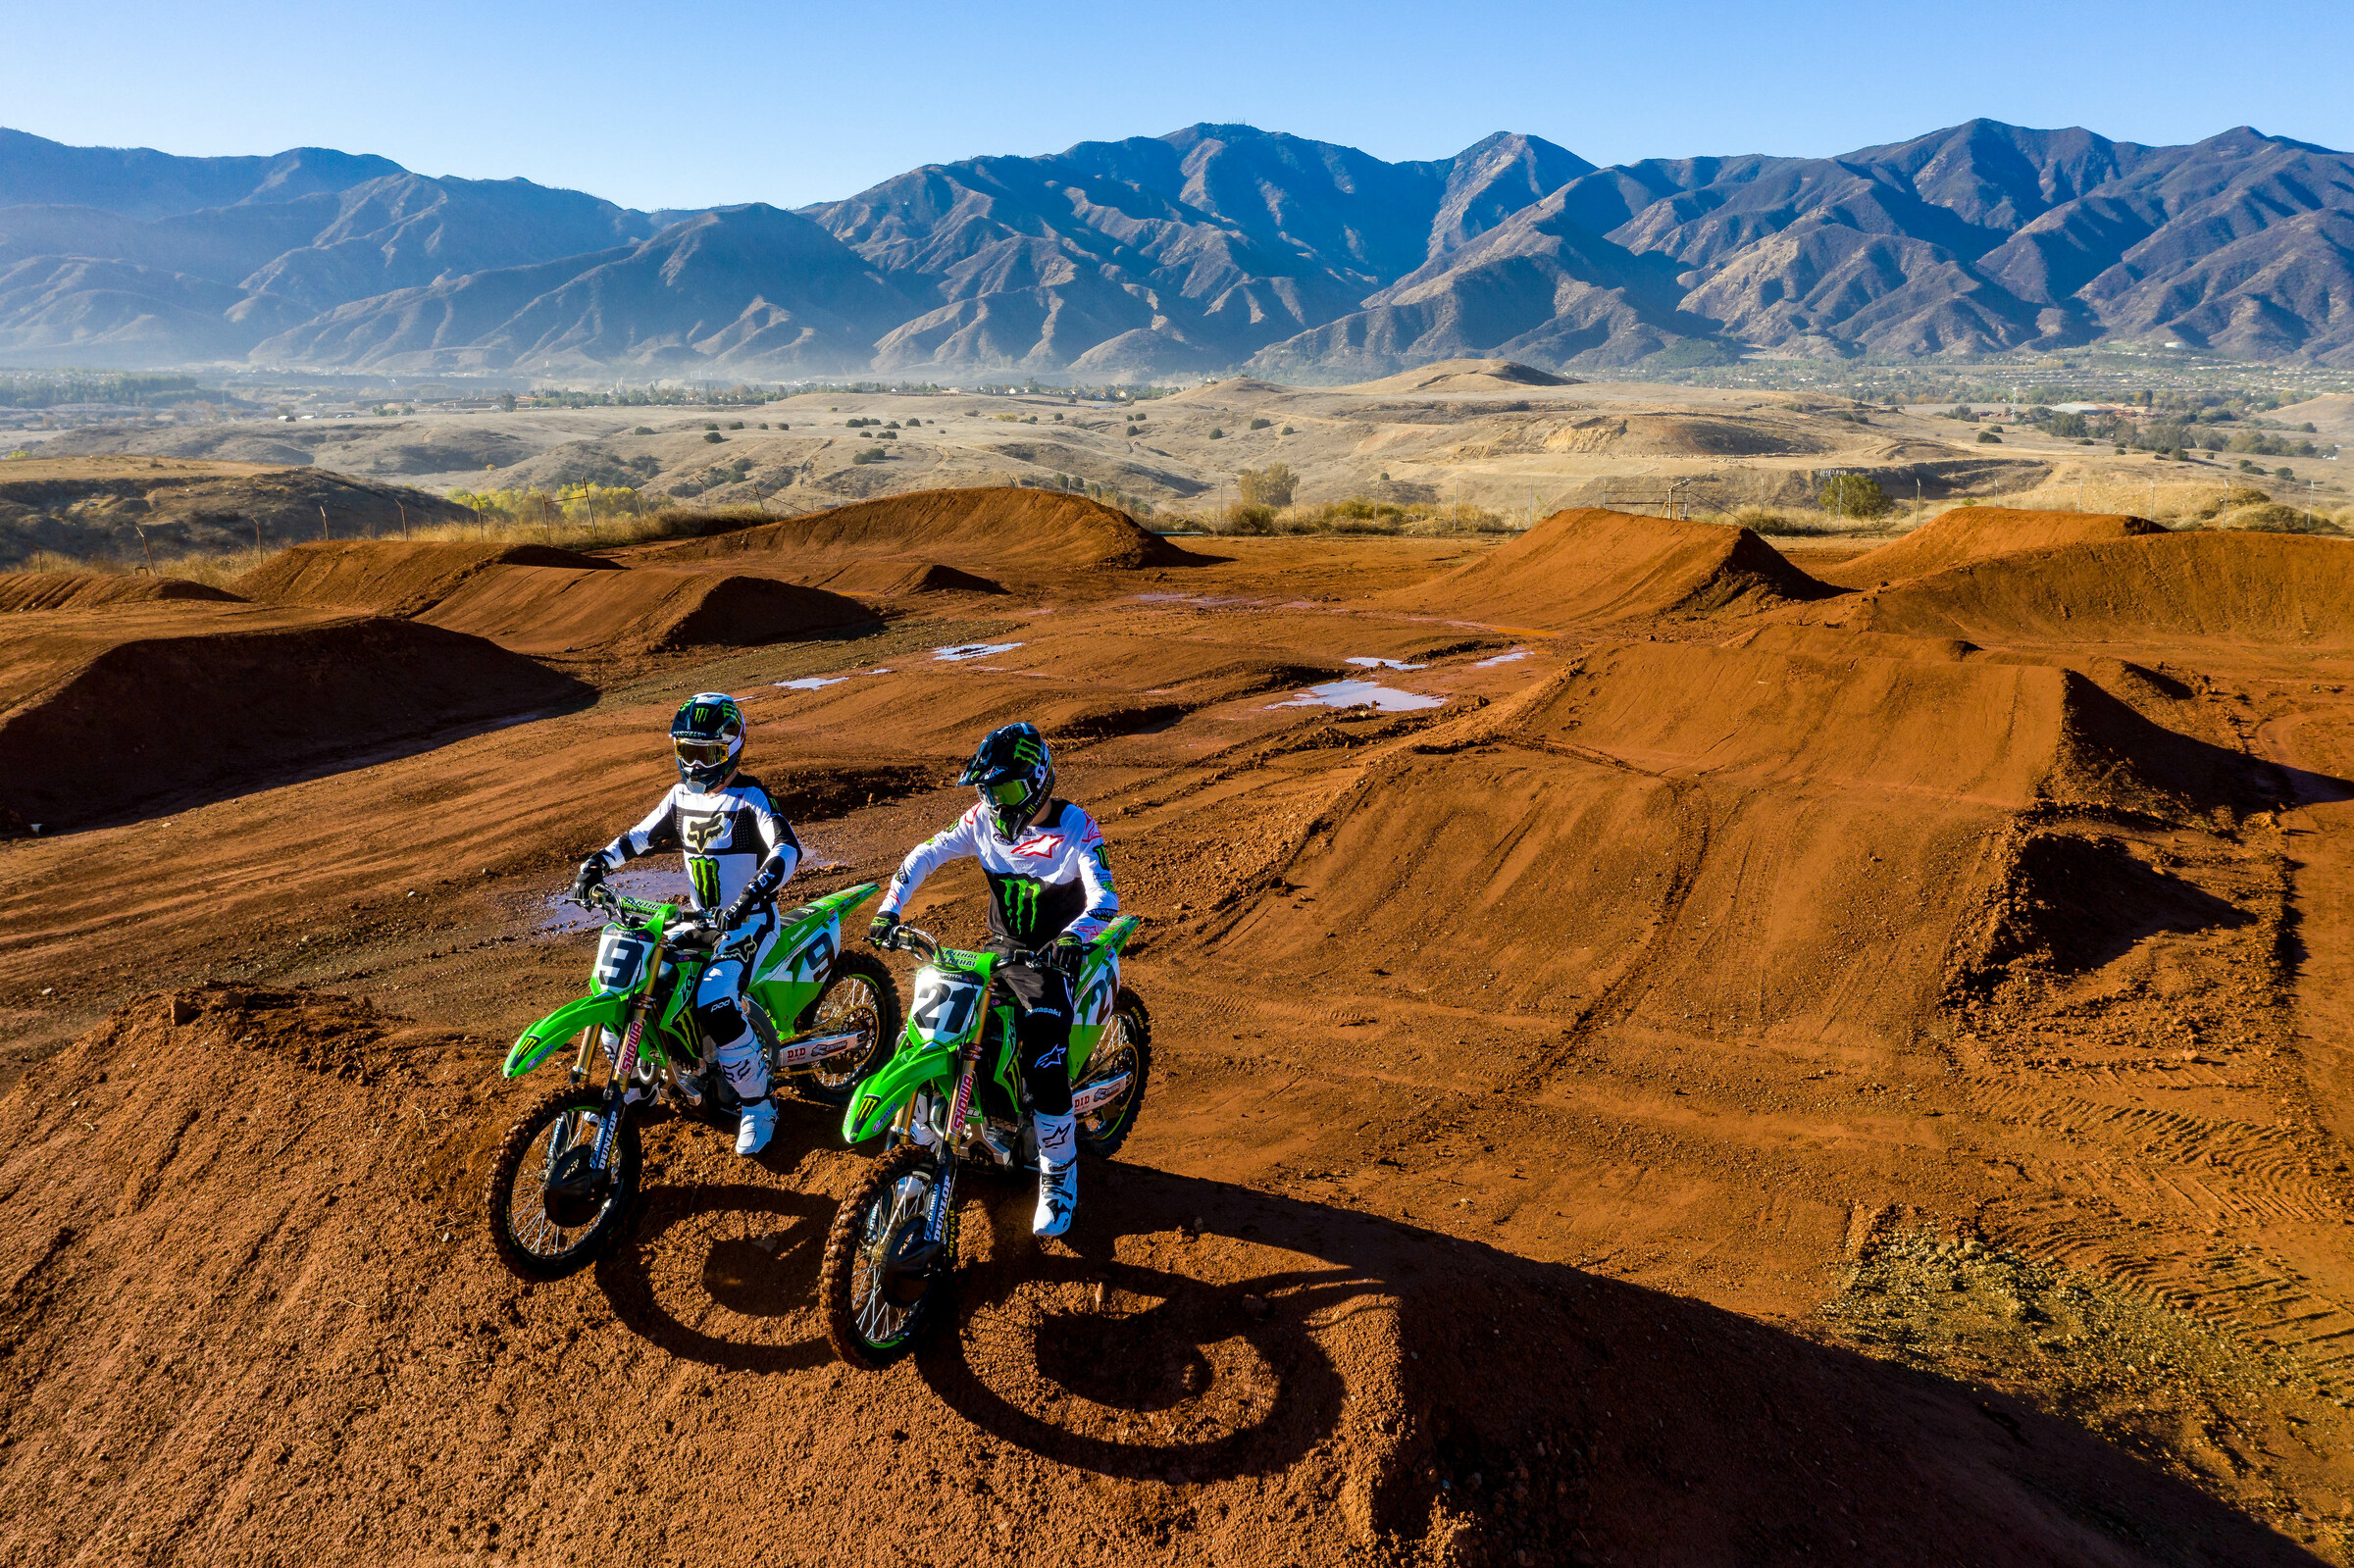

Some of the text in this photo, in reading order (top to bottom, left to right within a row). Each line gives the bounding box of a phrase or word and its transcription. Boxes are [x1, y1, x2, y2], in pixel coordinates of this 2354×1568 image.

[624, 897, 662, 910] RENTHA
[748, 868, 775, 893] FOX
[841, 896, 861, 914] DUNLOP
[724, 899, 742, 921] FOX
[598, 937, 645, 988] 9
[805, 932, 836, 983] 9
[710, 998, 731, 1013] pod
[913, 983, 979, 1034] 21
[1091, 964, 1118, 1026] 21
[621, 1020, 643, 1073] SHOWA
[952, 1073, 974, 1133] SHOWA
[598, 1111, 617, 1170] DUNLOP
[934, 1175, 950, 1242] DUNLOP
